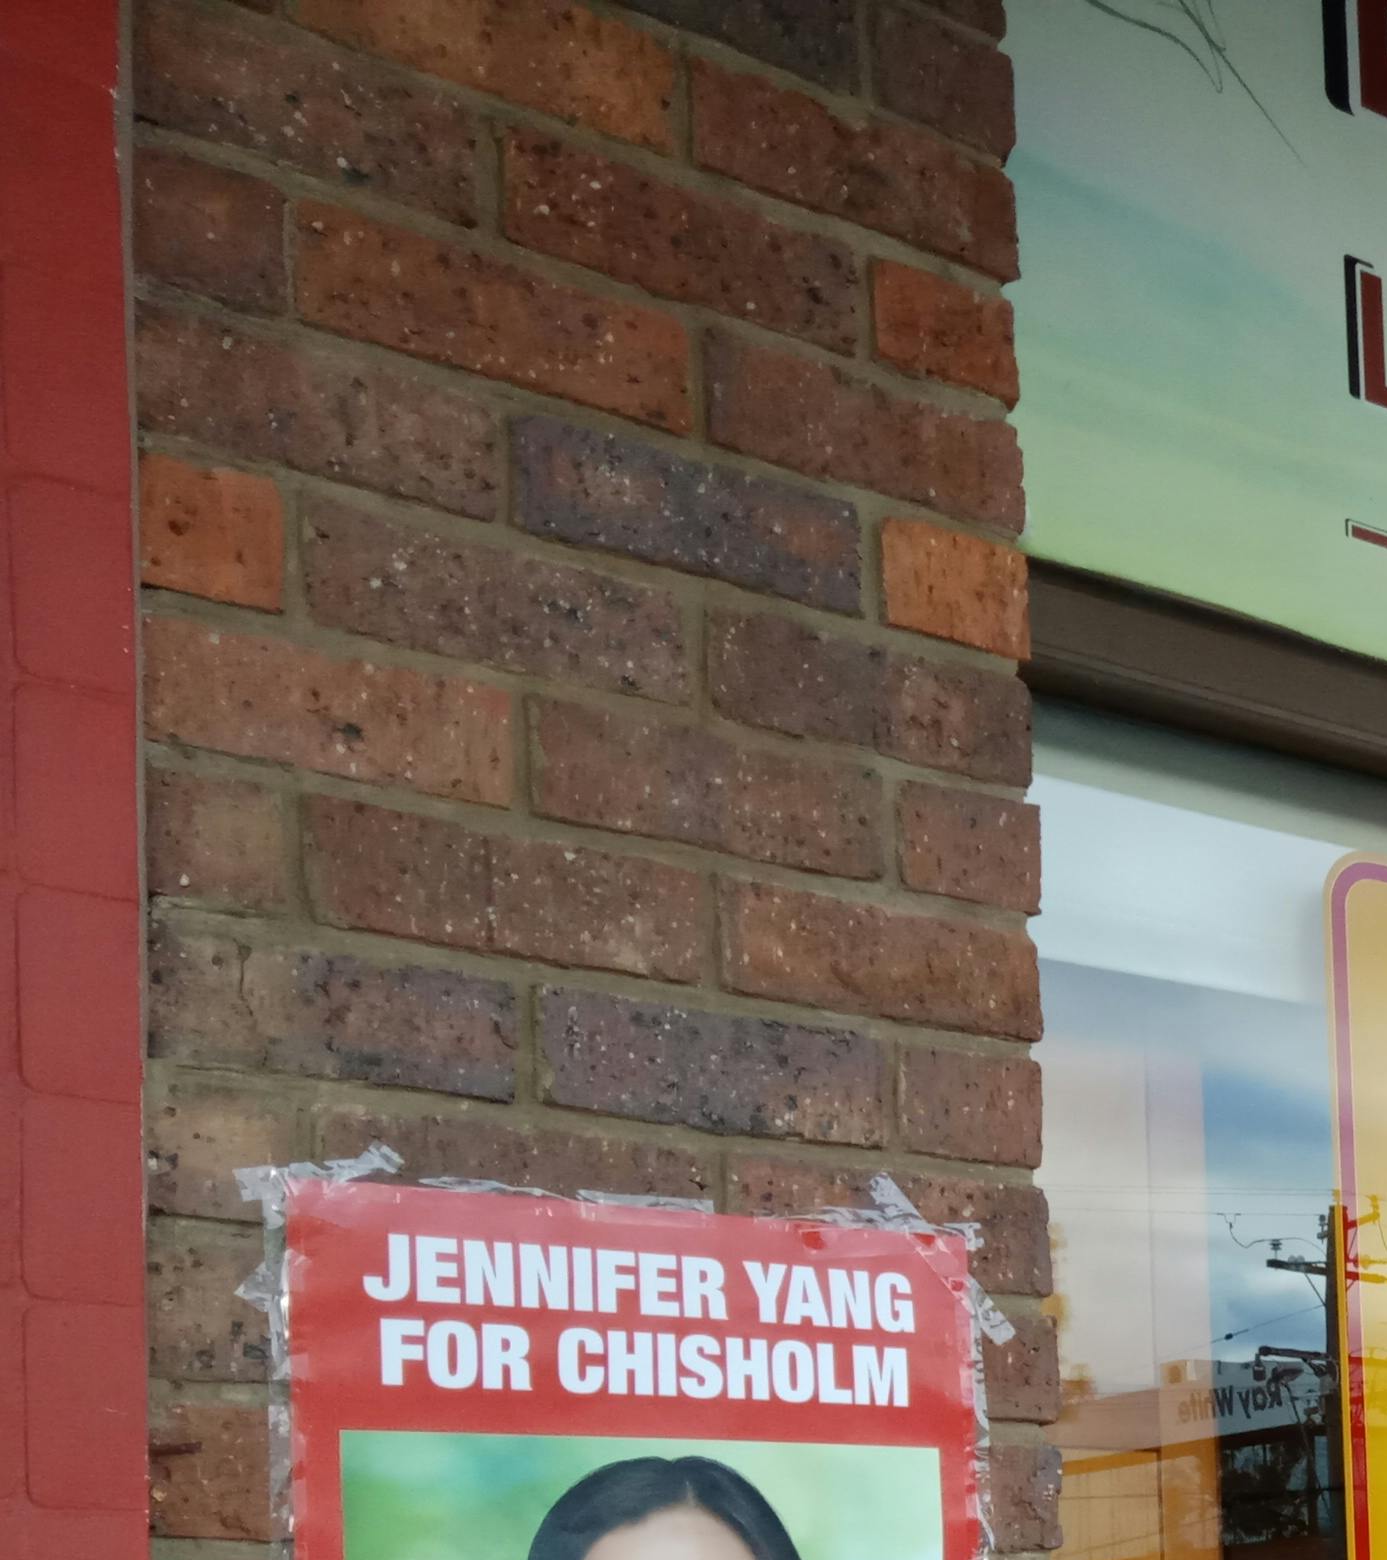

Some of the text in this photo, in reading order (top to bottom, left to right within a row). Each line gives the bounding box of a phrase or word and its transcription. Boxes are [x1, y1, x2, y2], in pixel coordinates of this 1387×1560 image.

[363, 1233, 916, 1333] JENNIFER YANG
[380, 1317, 910, 1407] FOR CHISHOLM
